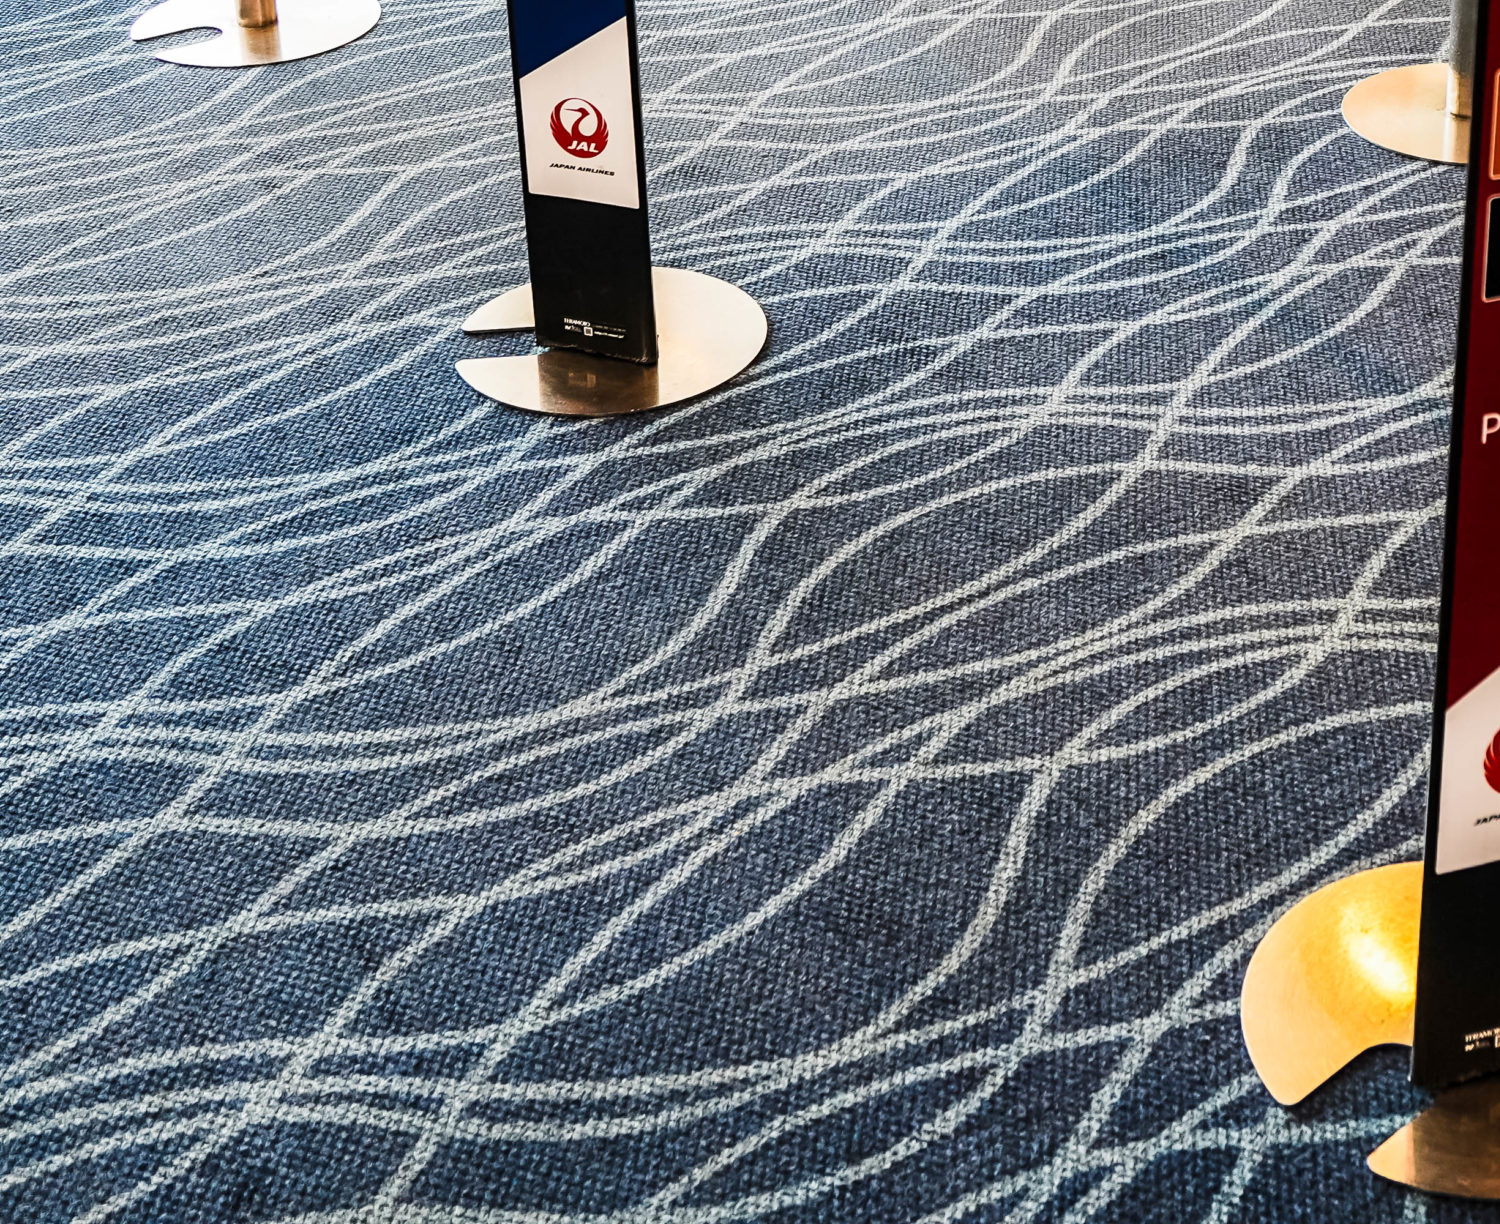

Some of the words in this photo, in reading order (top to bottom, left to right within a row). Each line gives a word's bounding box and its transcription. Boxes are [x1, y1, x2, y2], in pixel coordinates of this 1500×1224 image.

[566, 139, 600, 154] JAL
[549, 162, 577, 171] JAPAN
[577, 165, 615, 177] AIRLINES
